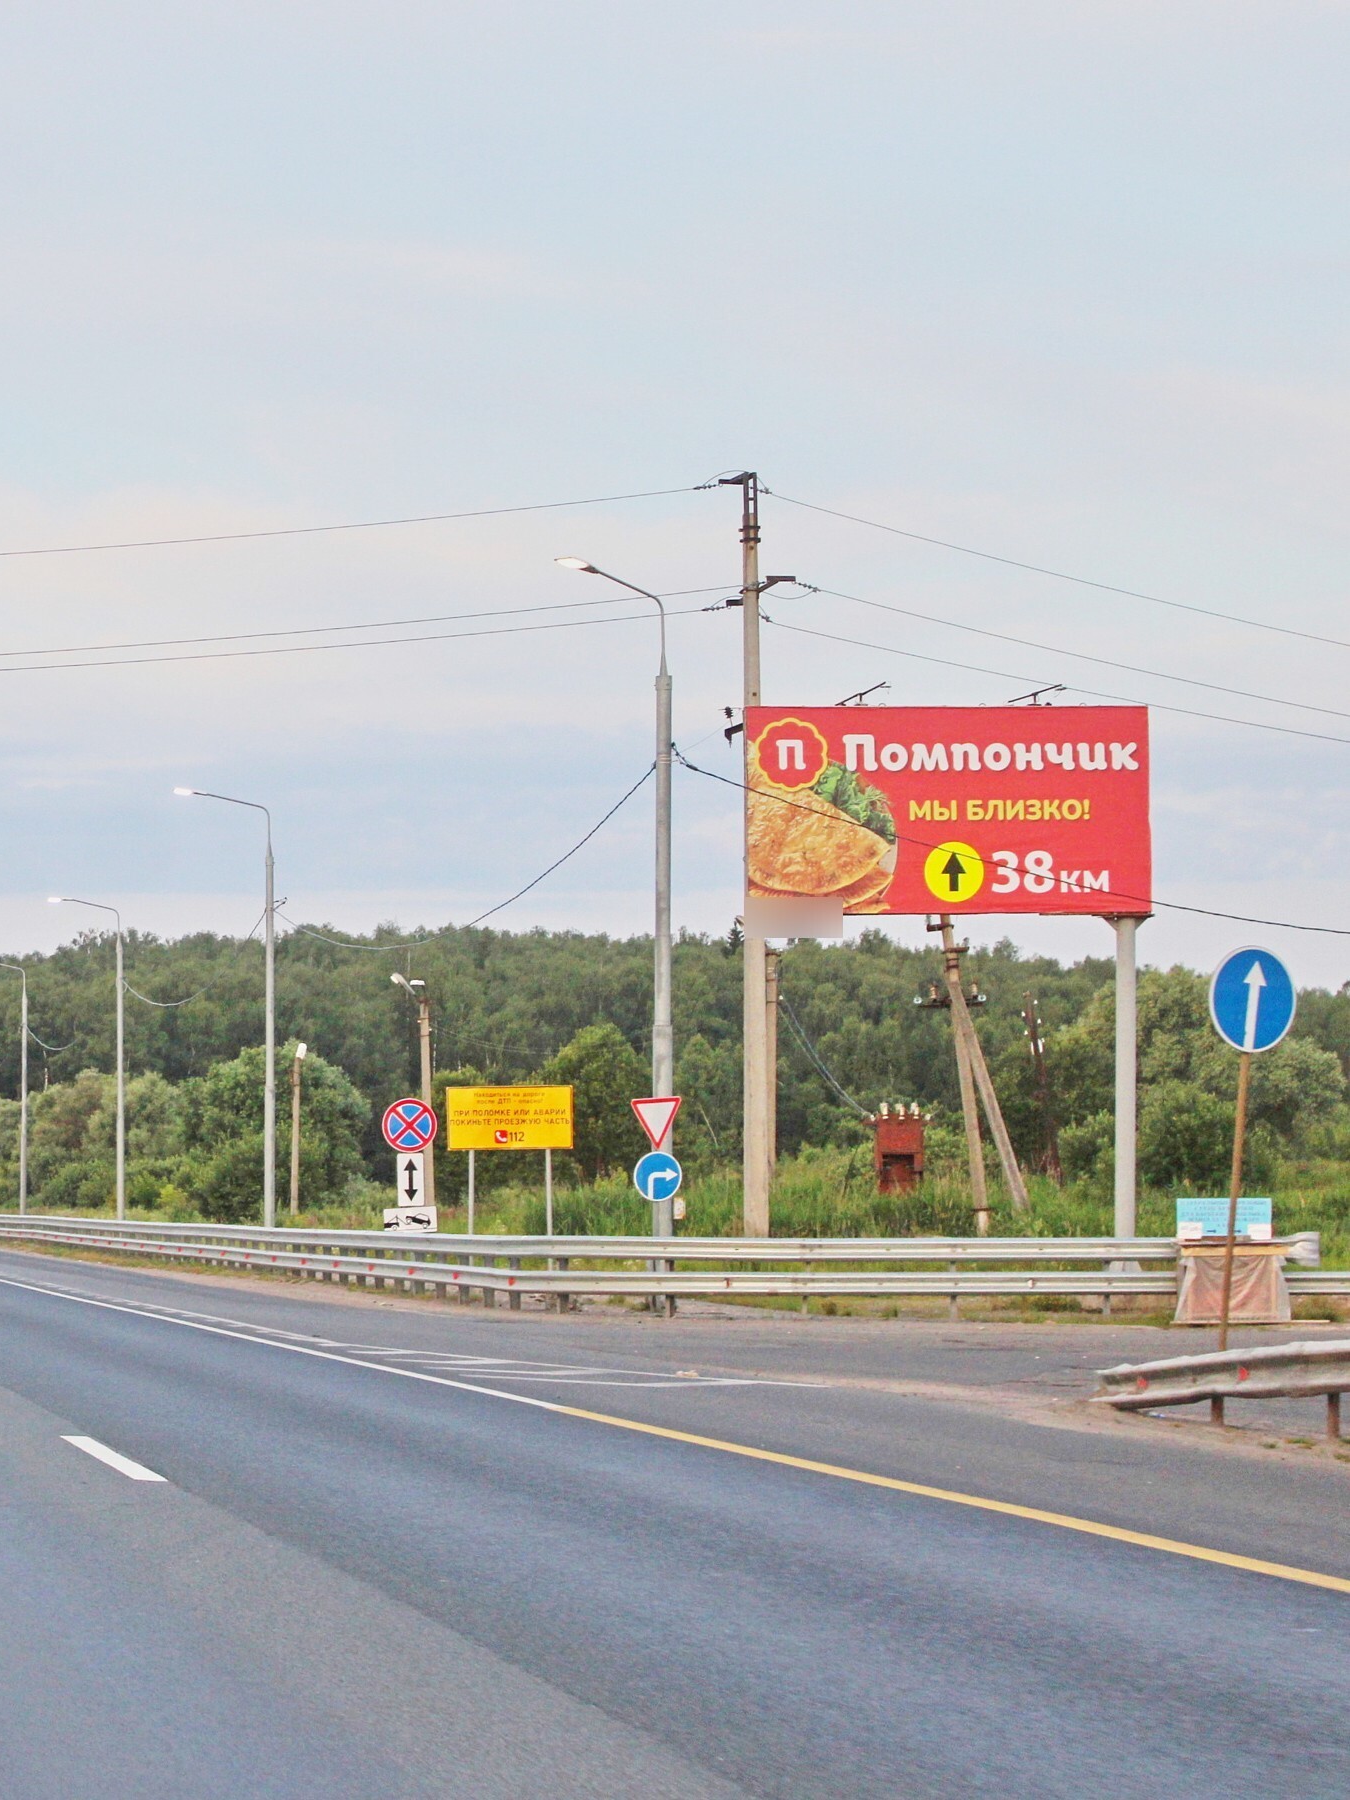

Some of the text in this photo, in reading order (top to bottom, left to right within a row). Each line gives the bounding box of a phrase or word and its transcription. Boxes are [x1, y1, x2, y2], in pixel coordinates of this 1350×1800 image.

[842, 733, 1140, 773] Помпончик
[909, 798, 1091, 821] МЫ БЛИЗКО!
[991, 849, 1055, 894] 38
[454, 1109, 470, 1117] ПРИ
[533, 1108, 566, 1116] АВАРИИ
[449, 1118, 492, 1126] ПОКИНЬТЕ
[545, 1117, 570, 1125] ЧАСТЬ
[509, 1131, 525, 1142] 112
